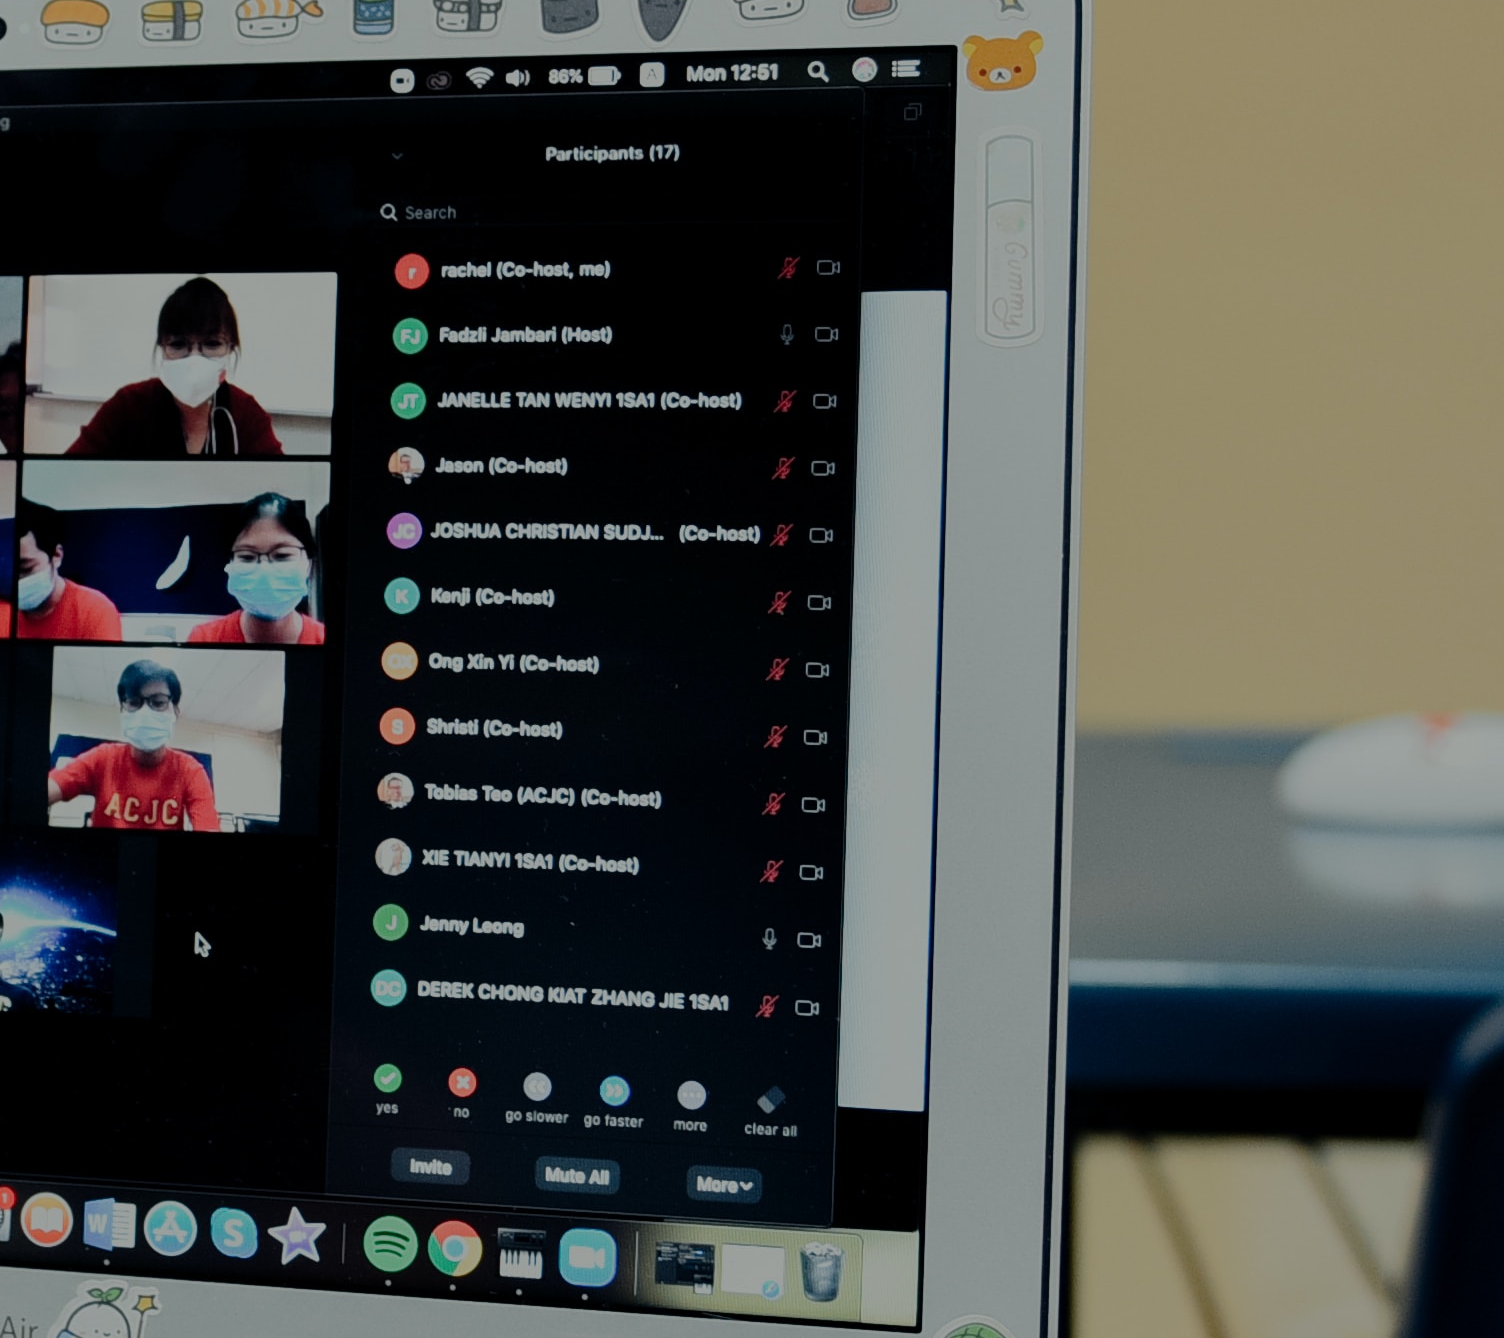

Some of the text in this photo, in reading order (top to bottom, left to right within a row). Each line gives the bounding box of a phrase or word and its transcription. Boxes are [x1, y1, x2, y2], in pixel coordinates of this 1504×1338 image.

[549, 69, 583, 84] 86%
[687, 64, 778, 82] Mon 12:51
[546, 144, 679, 163] Participants (17)
[406, 206, 456, 219] Search
[442, 261, 610, 279] rachel (Co-host, me)
[402, 329, 421, 345] FJ
[440, 326, 612, 344] Fadzli Jambari (Host)
[398, 393, 417, 411] JT
[438, 392, 741, 410] JANELLE TAN WENYI 1SA1 (Co-host)
[435, 457, 567, 476] Jason (Co-host)
[393, 524, 415, 539] JC
[431, 522, 501, 538] JOSHUA
[506, 523, 599, 539] CHRISTIAN
[679, 525, 760, 544] (Co-host)
[395, 588, 409, 604] K
[431, 587, 554, 607] Kenji (Co-host)
[429, 653, 599, 674] Ong Xin Yi (Co-host)
[392, 719, 403, 734] S
[427, 718, 562, 740] Shristi (Co-host)
[424, 783, 661, 809] Tobias Teo (ACJC) (Co-host)
[103, 792, 180, 826] ACJC
[422, 849, 639, 875] XIE TIANYI 1SA1 (Co-host)
[386, 916, 397, 931] J
[420, 915, 524, 938] Jenny Leong
[375, 981, 401, 997] DC
[418, 981, 728, 1011] DEREK CHONG KIAT ZHANG JIE 1SA1
[376, 1104, 398, 1115] yes
[454, 1108, 469, 1118] no
[506, 1111, 569, 1123] go slower
[584, 1114, 643, 1128] go faster
[674, 1120, 707, 1131] more
[745, 1123, 797, 1136] clear all
[410, 1159, 452, 1175] Invite
[546, 1167, 609, 1185] Mute All
[697, 1176, 738, 1193] More
